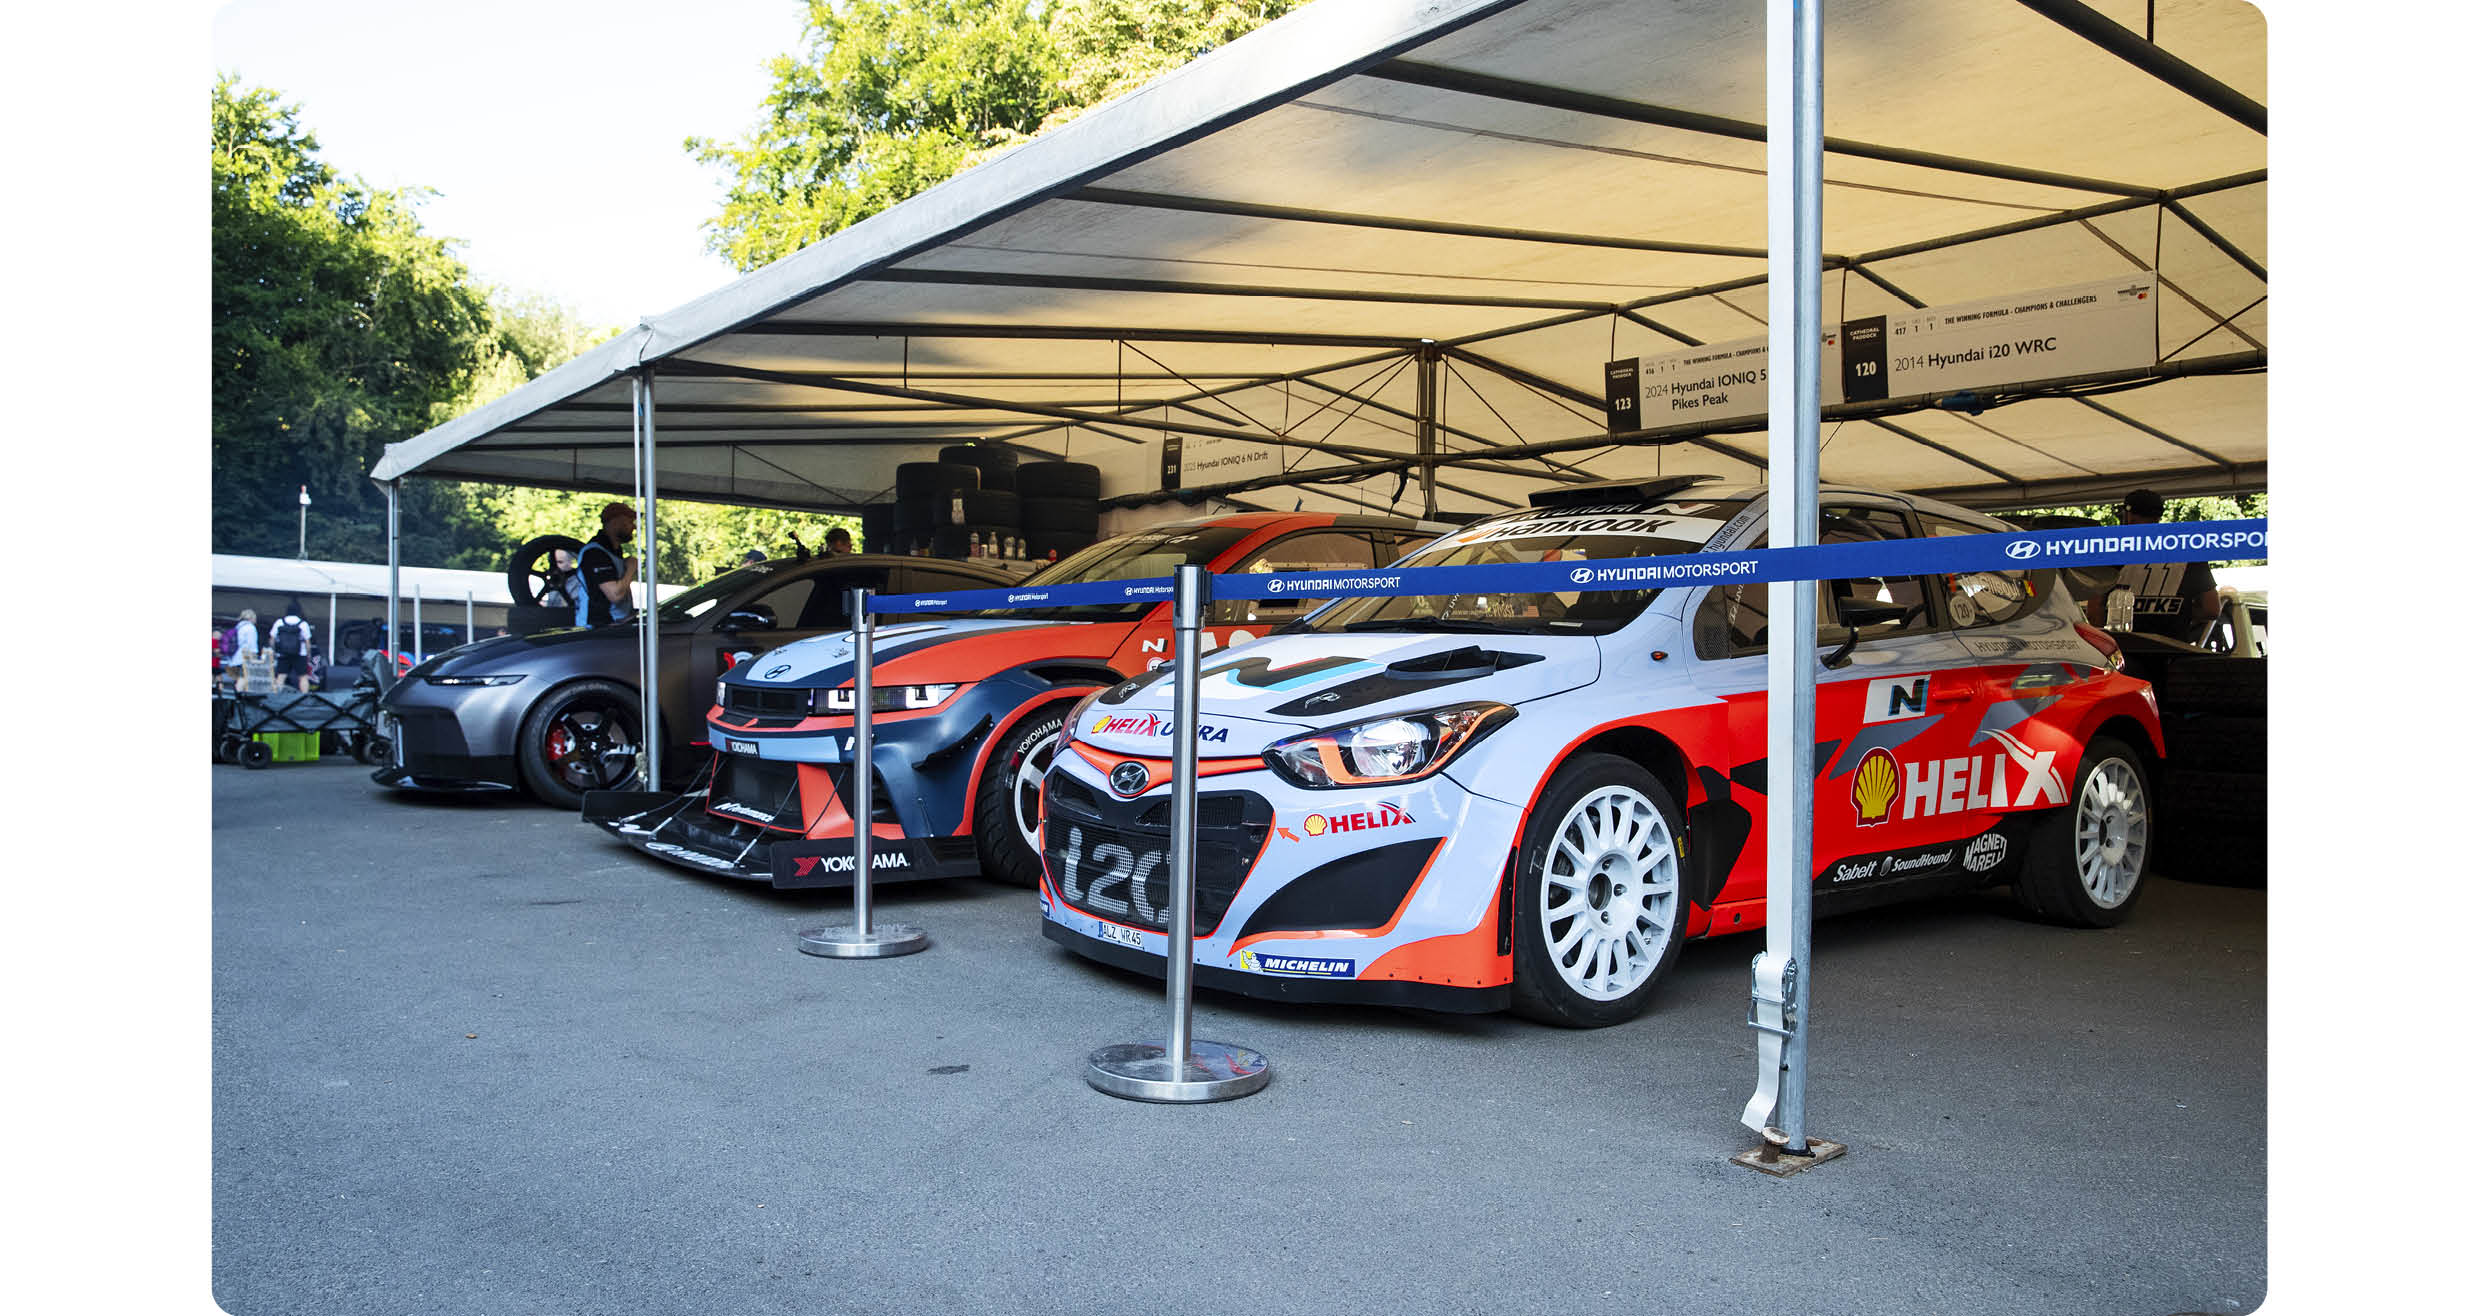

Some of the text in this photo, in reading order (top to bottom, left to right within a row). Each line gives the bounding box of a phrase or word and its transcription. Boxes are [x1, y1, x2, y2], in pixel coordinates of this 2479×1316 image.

[1944, 317, 1955, 325] THE
[1956, 313, 1981, 324] WINNING
[1982, 308, 2009, 320] FORMULA
[2014, 303, 2048, 314] CHAMPIONS
[2055, 295, 2097, 308] CHALLENGERS
[1895, 327, 1906, 335] 417
[1894, 337, 2057, 372] 2014 Hyundai i20 WRC
[1855, 361, 1877, 377] 120
[1645, 369, 1767, 399] 2024 Hyundai IONIQ 5
[1615, 397, 1632, 410] 123
[1672, 392, 1729, 411] Pikes Peak
[1196, 459, 1220, 472] Hyundai
[1220, 455, 1241, 467] IONIQ
[2046, 531, 2268, 556] HYUNDAI MOTORSPO
[1597, 560, 1759, 581] HYUNDAI MOTORSPORT
[1286, 576, 1401, 592] HYUNDAI MOTORSPORT
[1888, 678, 1932, 717] N
[1016, 718, 1063, 754] YOKOHAMA
[1103, 712, 1229, 743] HELIX URA
[1902, 729, 2070, 821] HELIX
[1330, 801, 1416, 834] HELIX
[820, 852, 908, 873] YOKOAMA
[1833, 860, 1877, 882] Sabelt
[1891, 849, 1952, 872] SoundHound
[1264, 958, 1349, 973] MICHELIN
